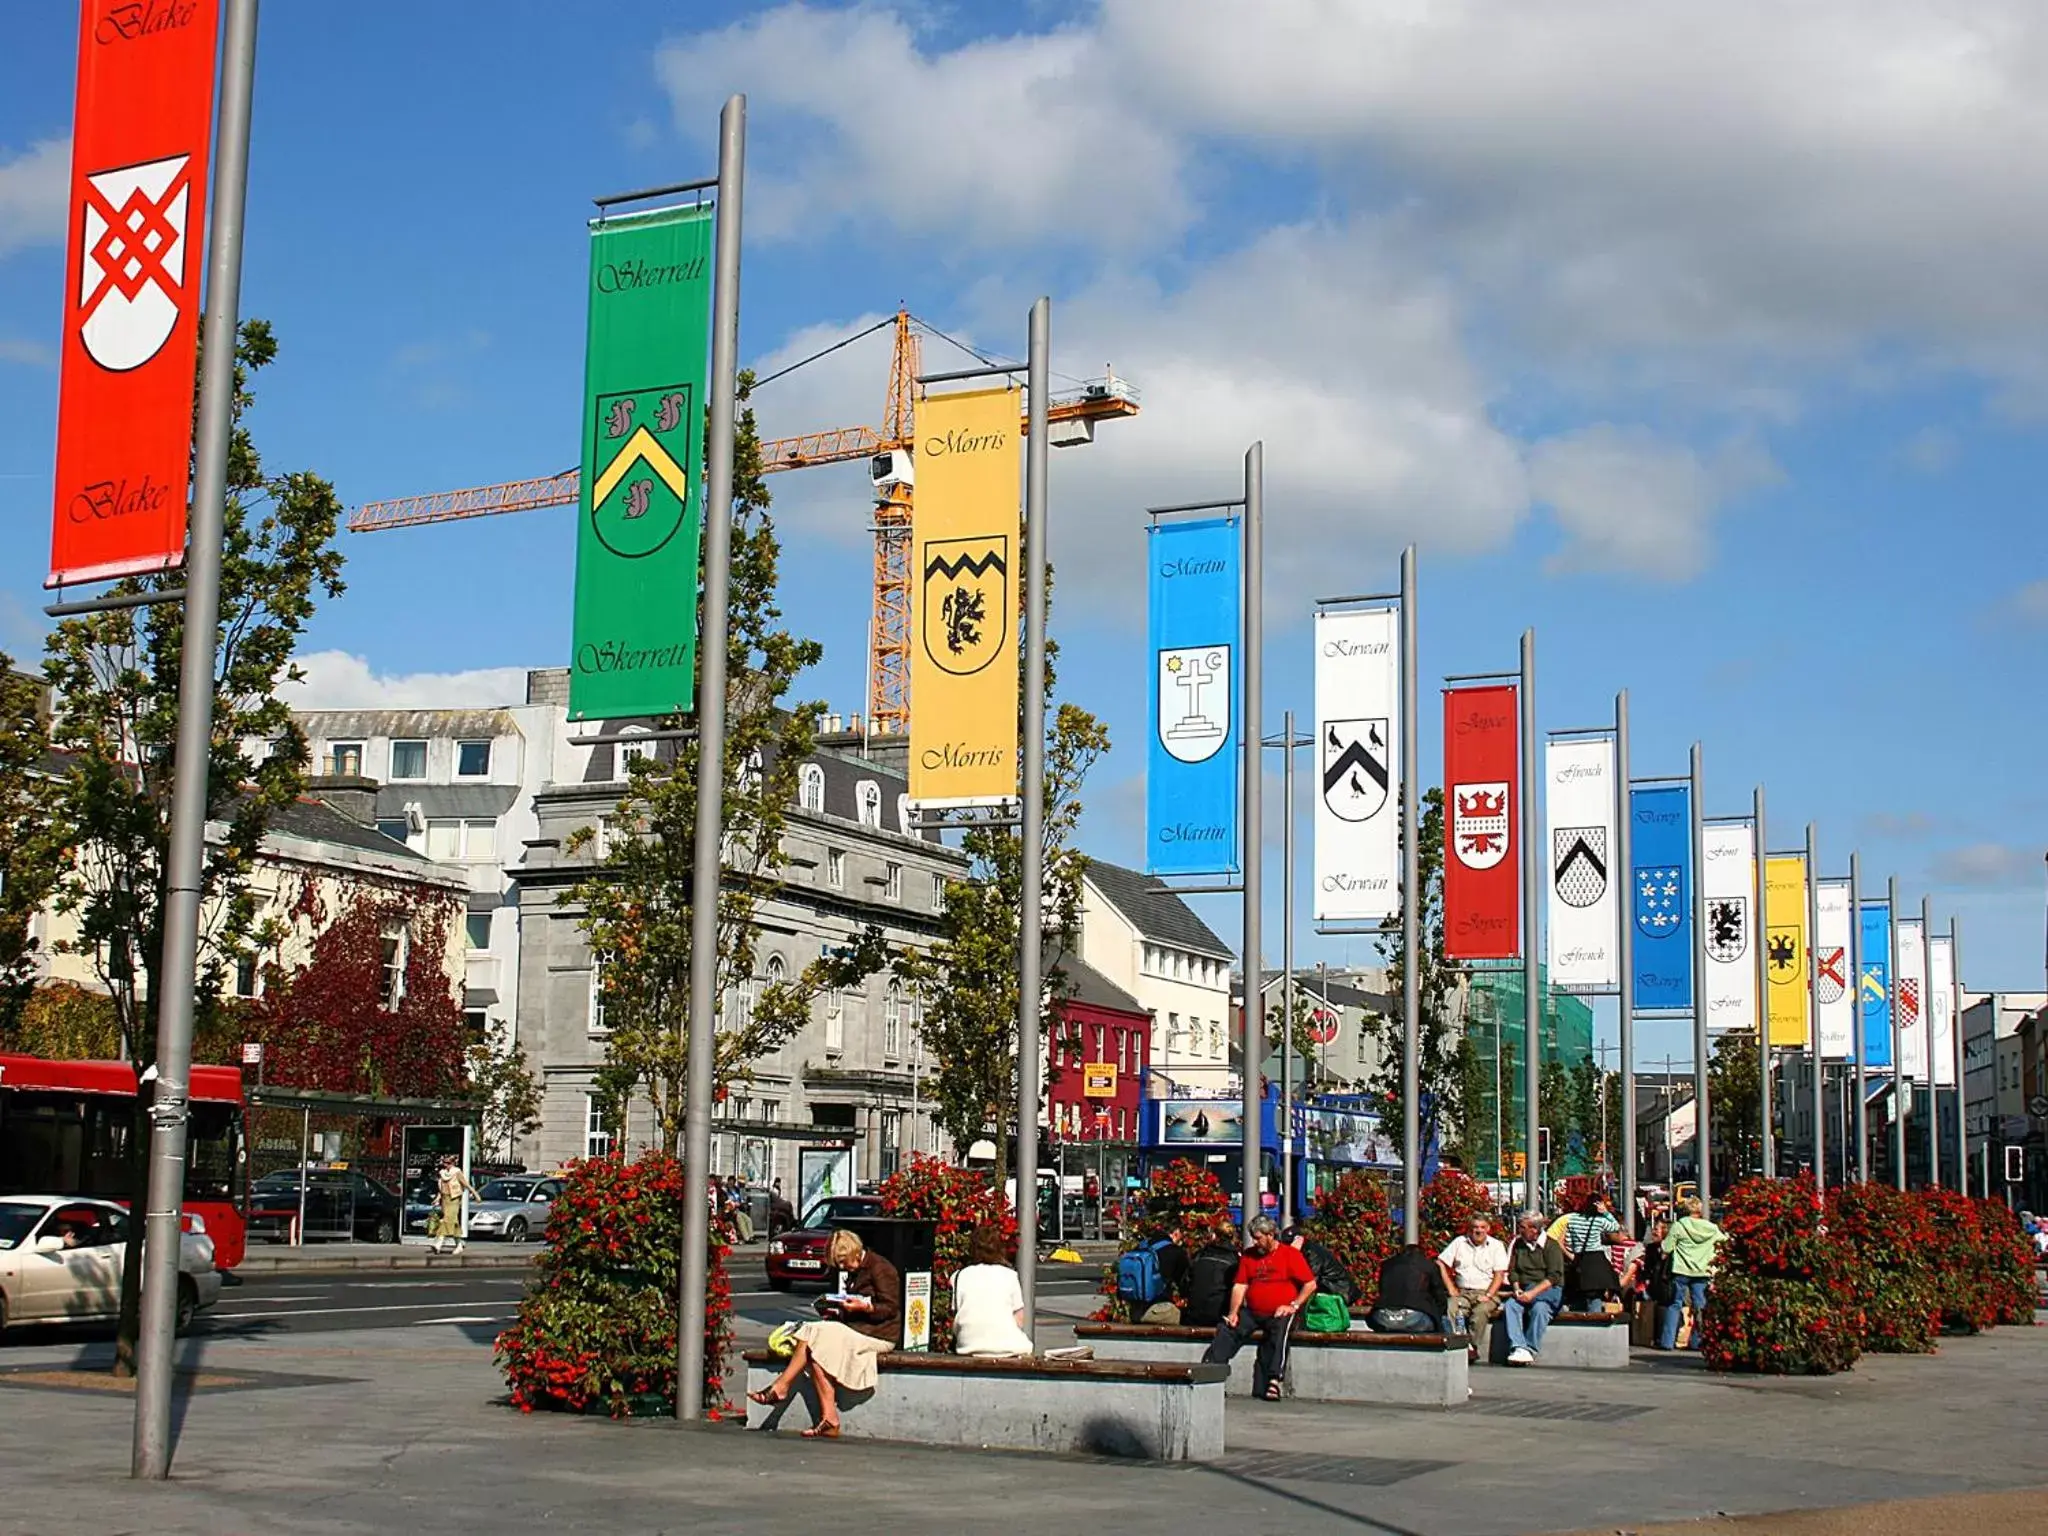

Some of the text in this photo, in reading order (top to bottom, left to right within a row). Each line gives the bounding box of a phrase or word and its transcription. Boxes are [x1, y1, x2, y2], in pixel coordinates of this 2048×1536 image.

[95, 0, 197, 45] Blake
[597, 256, 705, 293] Skerrett
[925, 427, 1006, 457] Morris
[69, 475, 169, 523] Blake
[1160, 556, 1226, 578] Martin
[577, 640, 687, 674] Skerrett
[1323, 639, 1390, 658] Kirwan
[921, 742, 1003, 770] Morris
[1159, 822, 1226, 843] Martin
[1322, 873, 1389, 893] Kirwan
